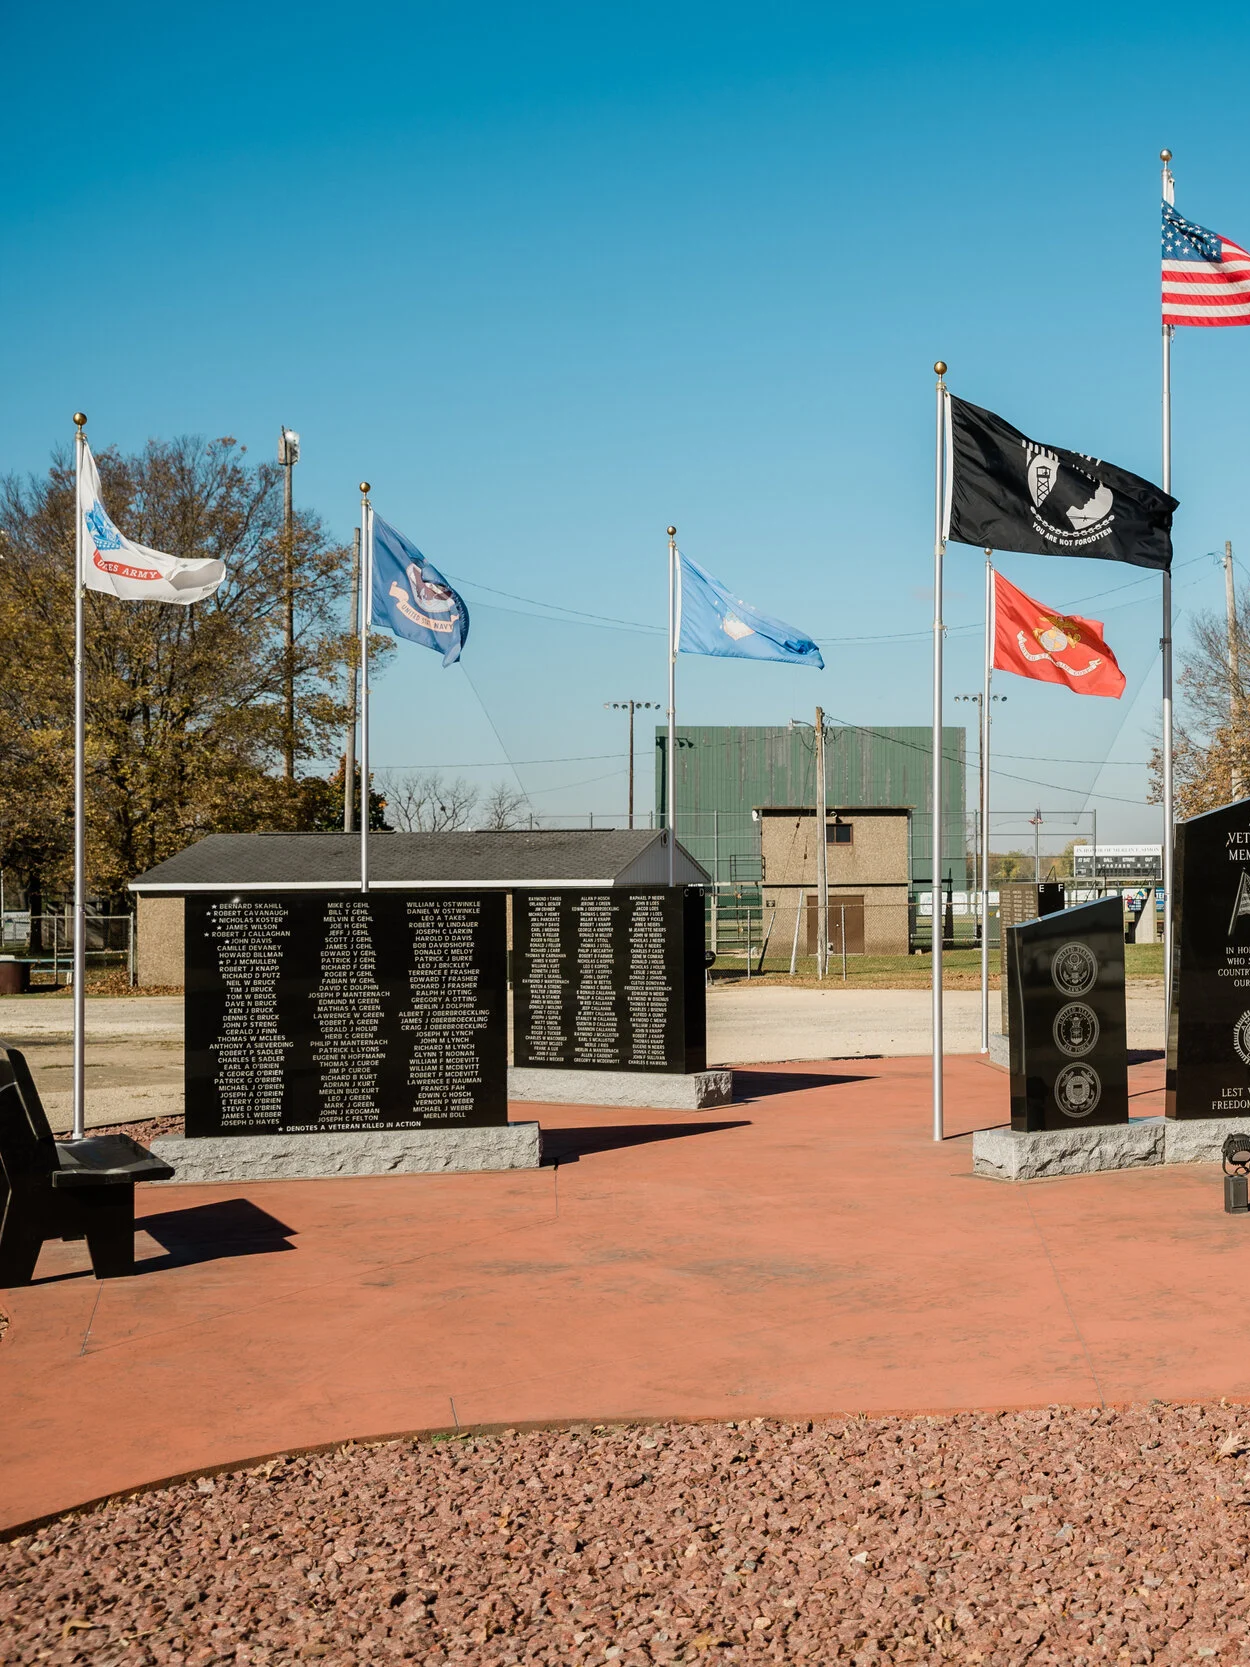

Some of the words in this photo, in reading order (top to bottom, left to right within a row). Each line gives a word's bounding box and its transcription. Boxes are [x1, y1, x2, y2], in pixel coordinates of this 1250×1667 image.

[1032, 521, 1045, 535] YOU
[1045, 532, 1057, 544] ARE
[1075, 527, 1112, 546] FORGOTTEN
[122, 567, 157, 579] ARMY
[402, 604, 420, 621] UNITED
[433, 622, 454, 630] NAVY
[699, 888, 705, 896] D
[1039, 884, 1045, 892] E
[1058, 883, 1063, 892] F
[684, 888, 689, 897] C
[1234, 979, 1250, 987] OUR
[1222, 1088, 1243, 1097] LEST
